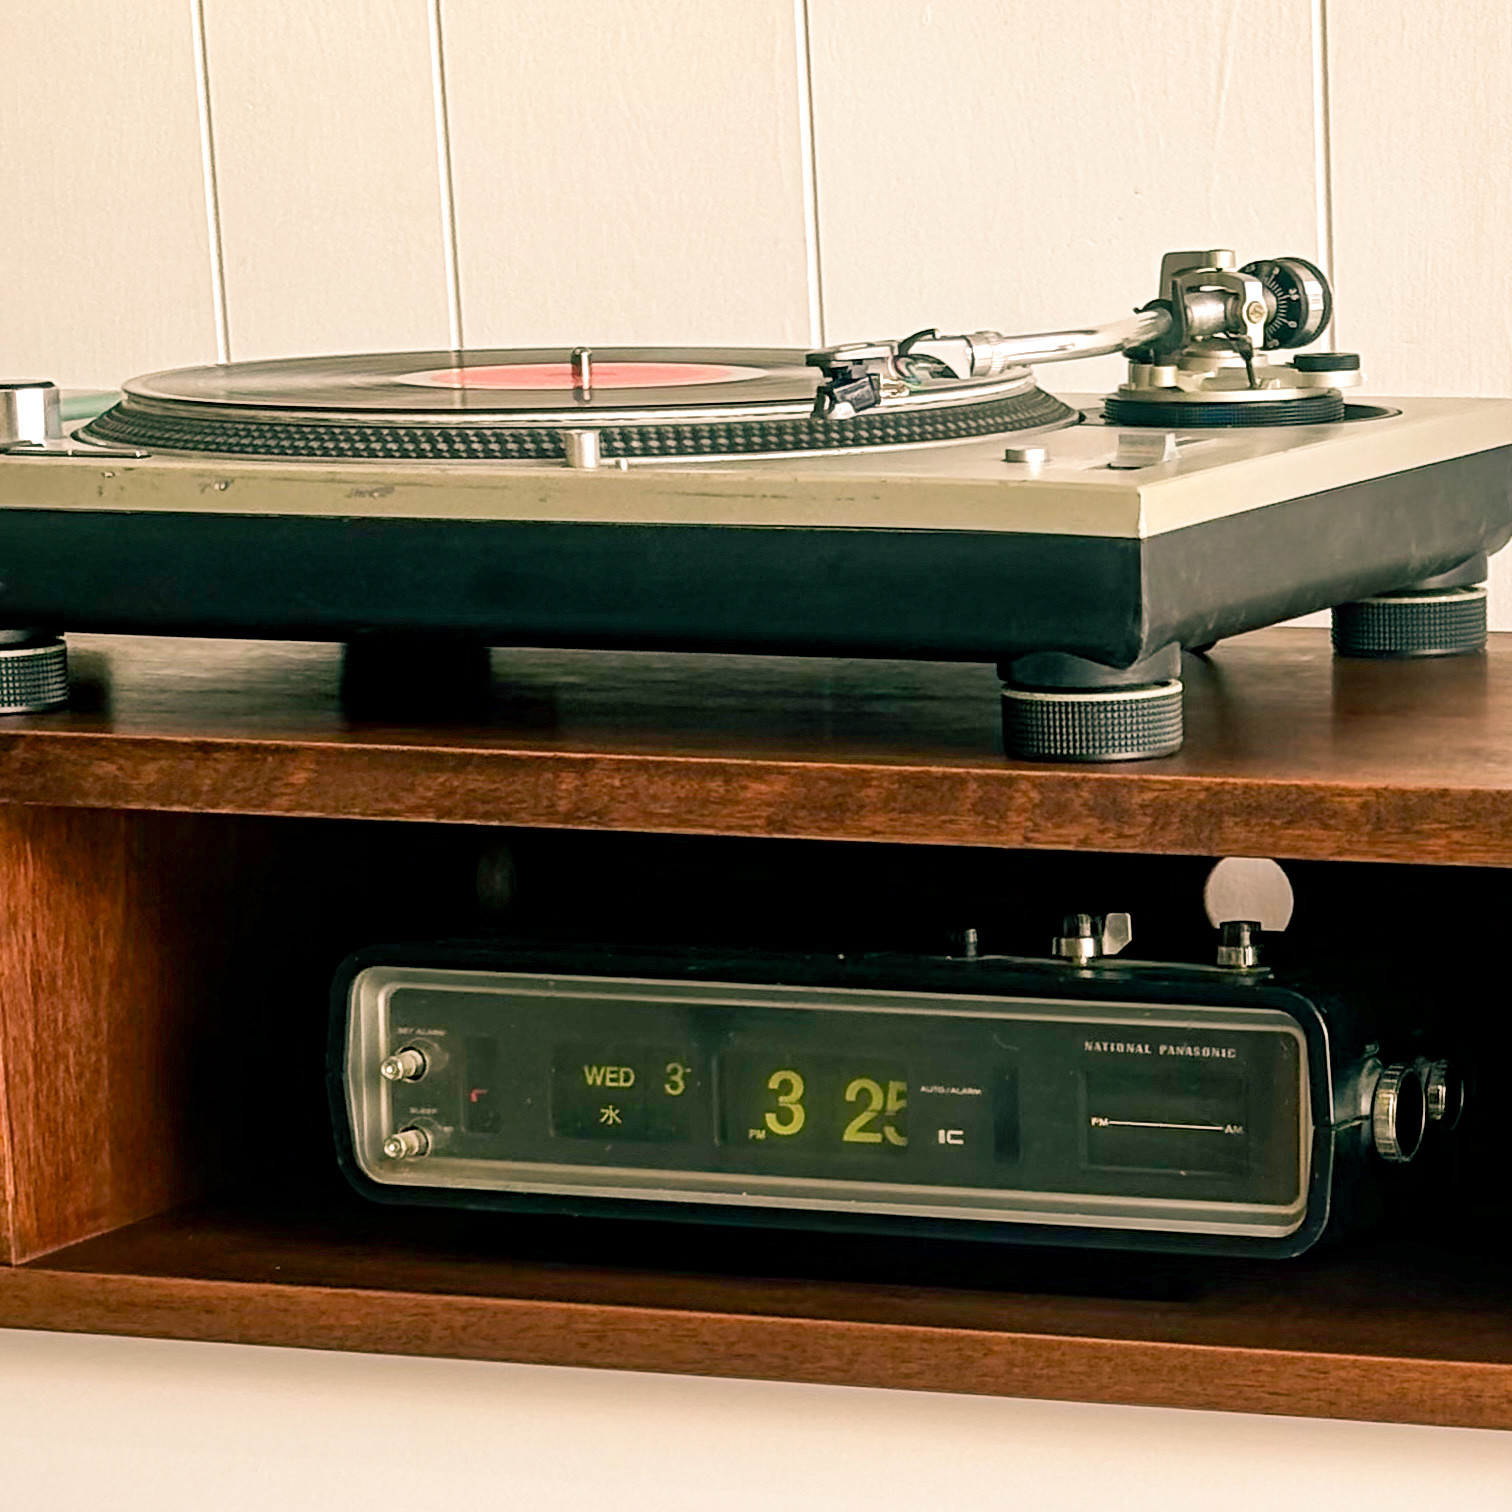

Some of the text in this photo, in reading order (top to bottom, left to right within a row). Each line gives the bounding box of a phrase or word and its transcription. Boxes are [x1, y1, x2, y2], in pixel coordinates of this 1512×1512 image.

[1084, 1041, 1237, 1059] NATIONAL PANASONIC
[584, 1062, 685, 1096] WED 3
[765, 1070, 805, 1135] 3
[600, 1104, 622, 1125] 水
[938, 1129, 964, 1145] IC
